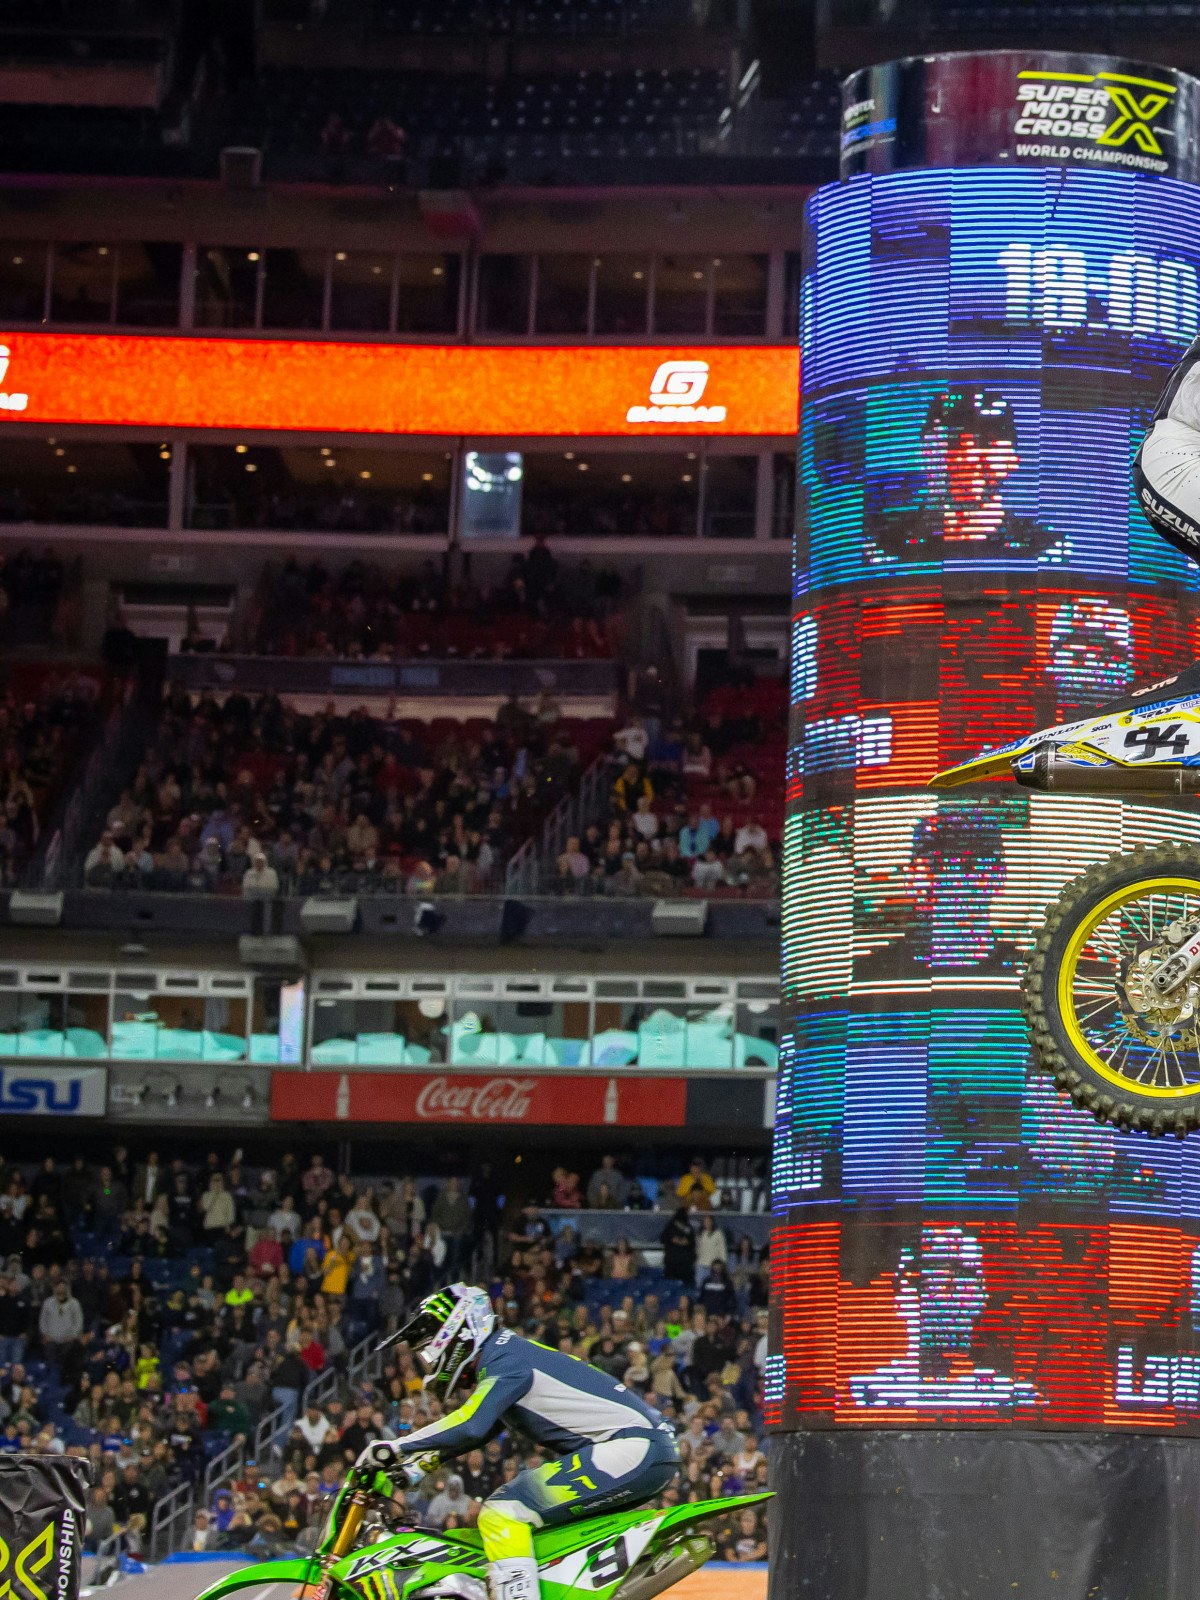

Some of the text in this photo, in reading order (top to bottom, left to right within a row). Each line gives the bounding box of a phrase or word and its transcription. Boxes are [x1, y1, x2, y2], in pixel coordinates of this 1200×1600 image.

[1016, 84, 1110, 106] SUPER
[1021, 101, 1106, 122] MOTO
[1014, 118, 1106, 139] CROSS
[1016, 144, 1169, 172] WORLD CHAMPIONSHIP
[1131, 676, 1179, 697] GUTS
[1028, 723, 1085, 745] DUNLOP
[1123, 723, 1190, 762] 94
[58, 1508, 75, 1600] IONSHIP
[586, 1535, 629, 1588] 9
